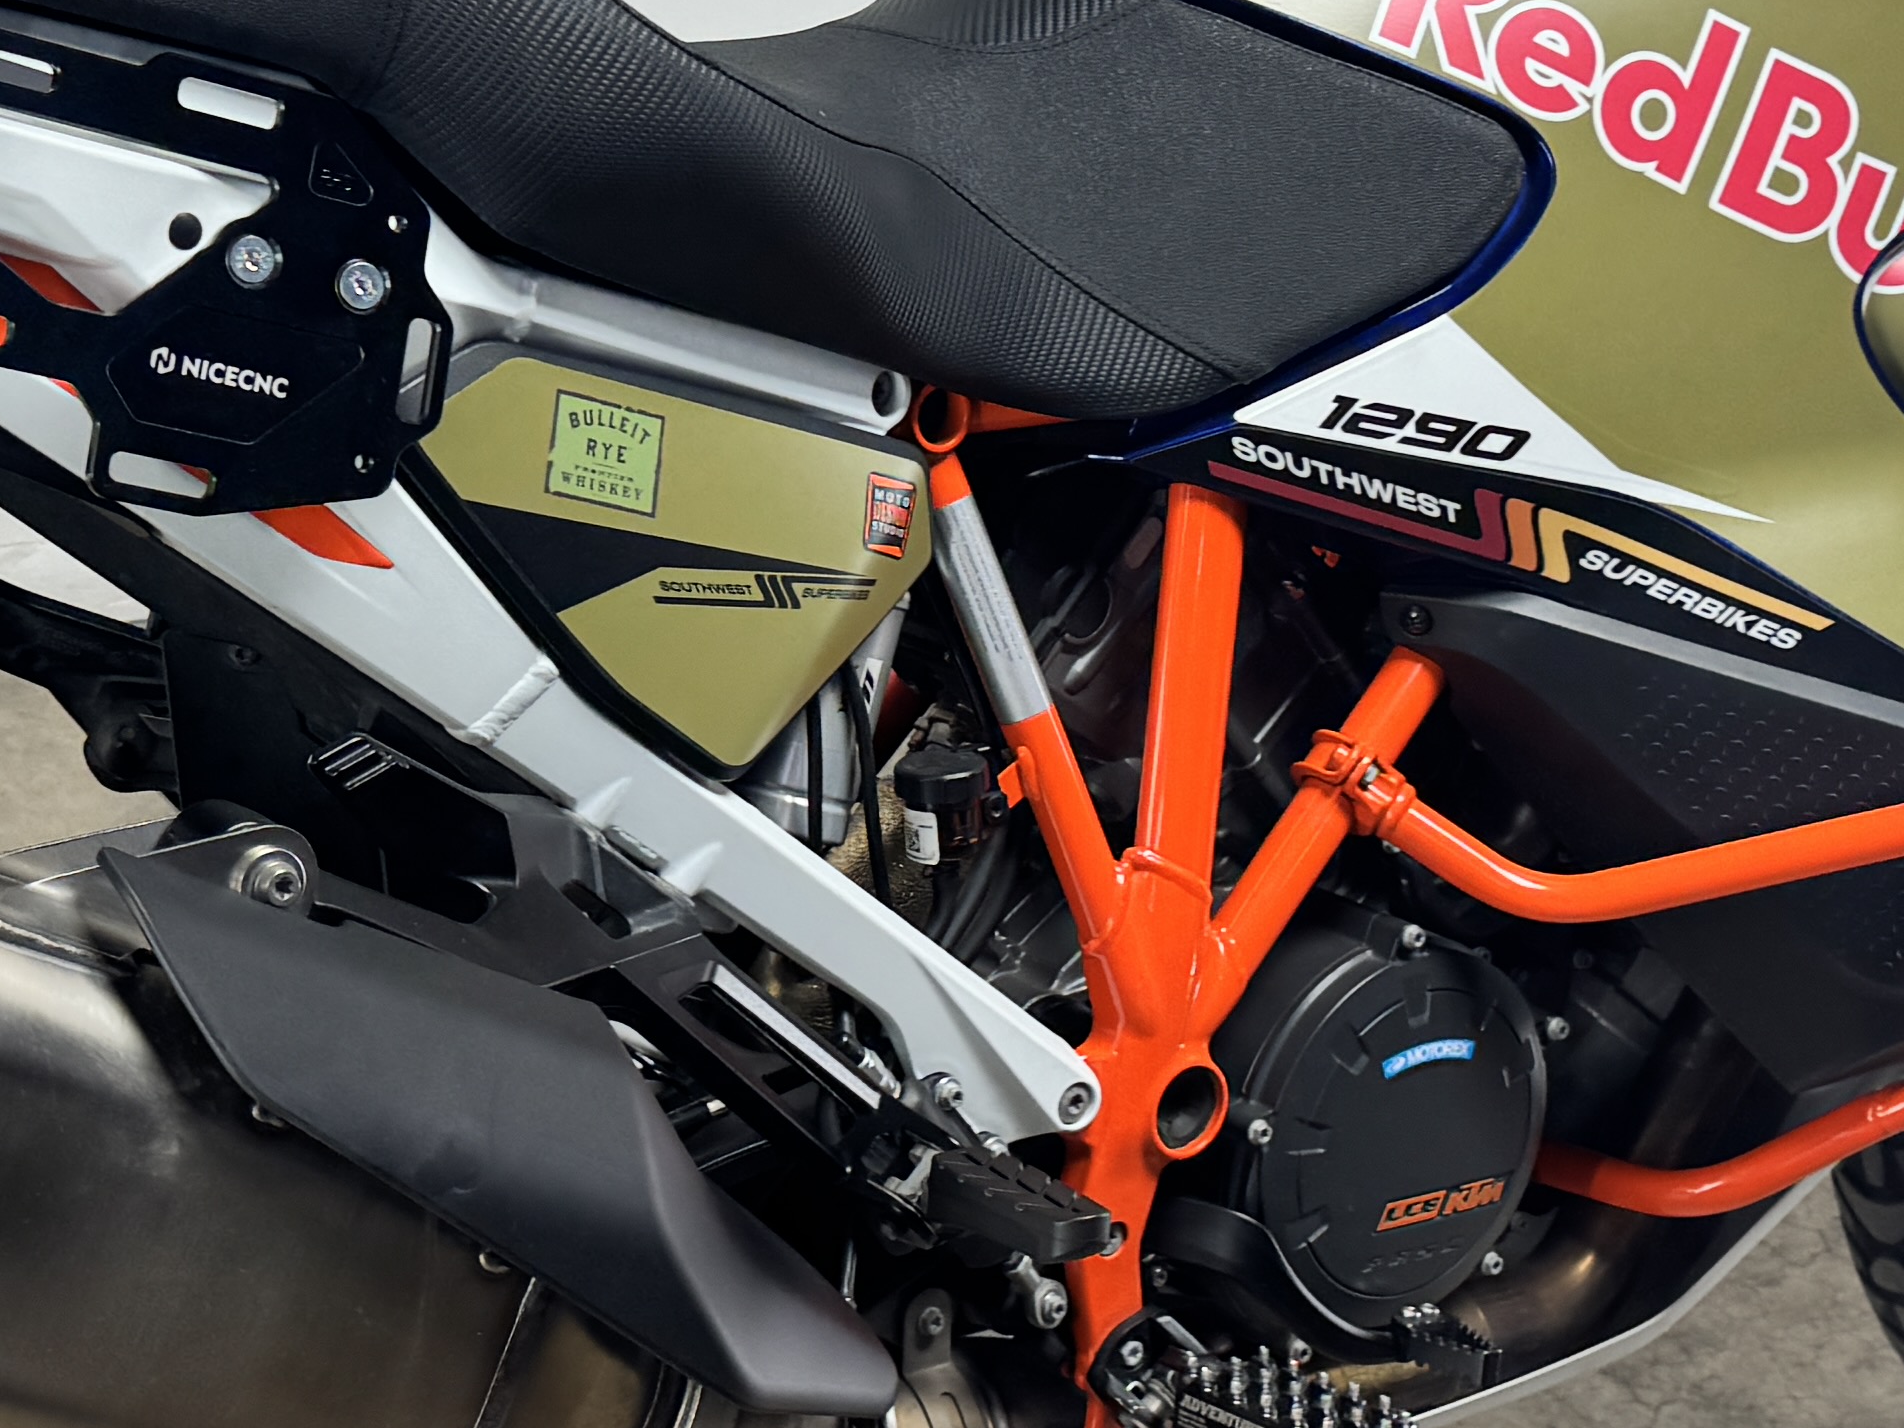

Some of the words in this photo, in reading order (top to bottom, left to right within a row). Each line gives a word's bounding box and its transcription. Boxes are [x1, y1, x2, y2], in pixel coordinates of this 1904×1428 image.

[180, 354, 289, 401] NICECNC
[568, 408, 652, 445] BULLEIT
[1318, 395, 1532, 463] 1290
[585, 437, 628, 464] RYE
[560, 471, 644, 501] WHISKEY
[874, 487, 910, 509] MOTO
[1231, 435, 1463, 525] SOUTHWEST
[658, 579, 753, 596] SOUTHWEST
[1578, 547, 1804, 653] SUPERBIKES
[1442, 1176, 1506, 1217] KTM
